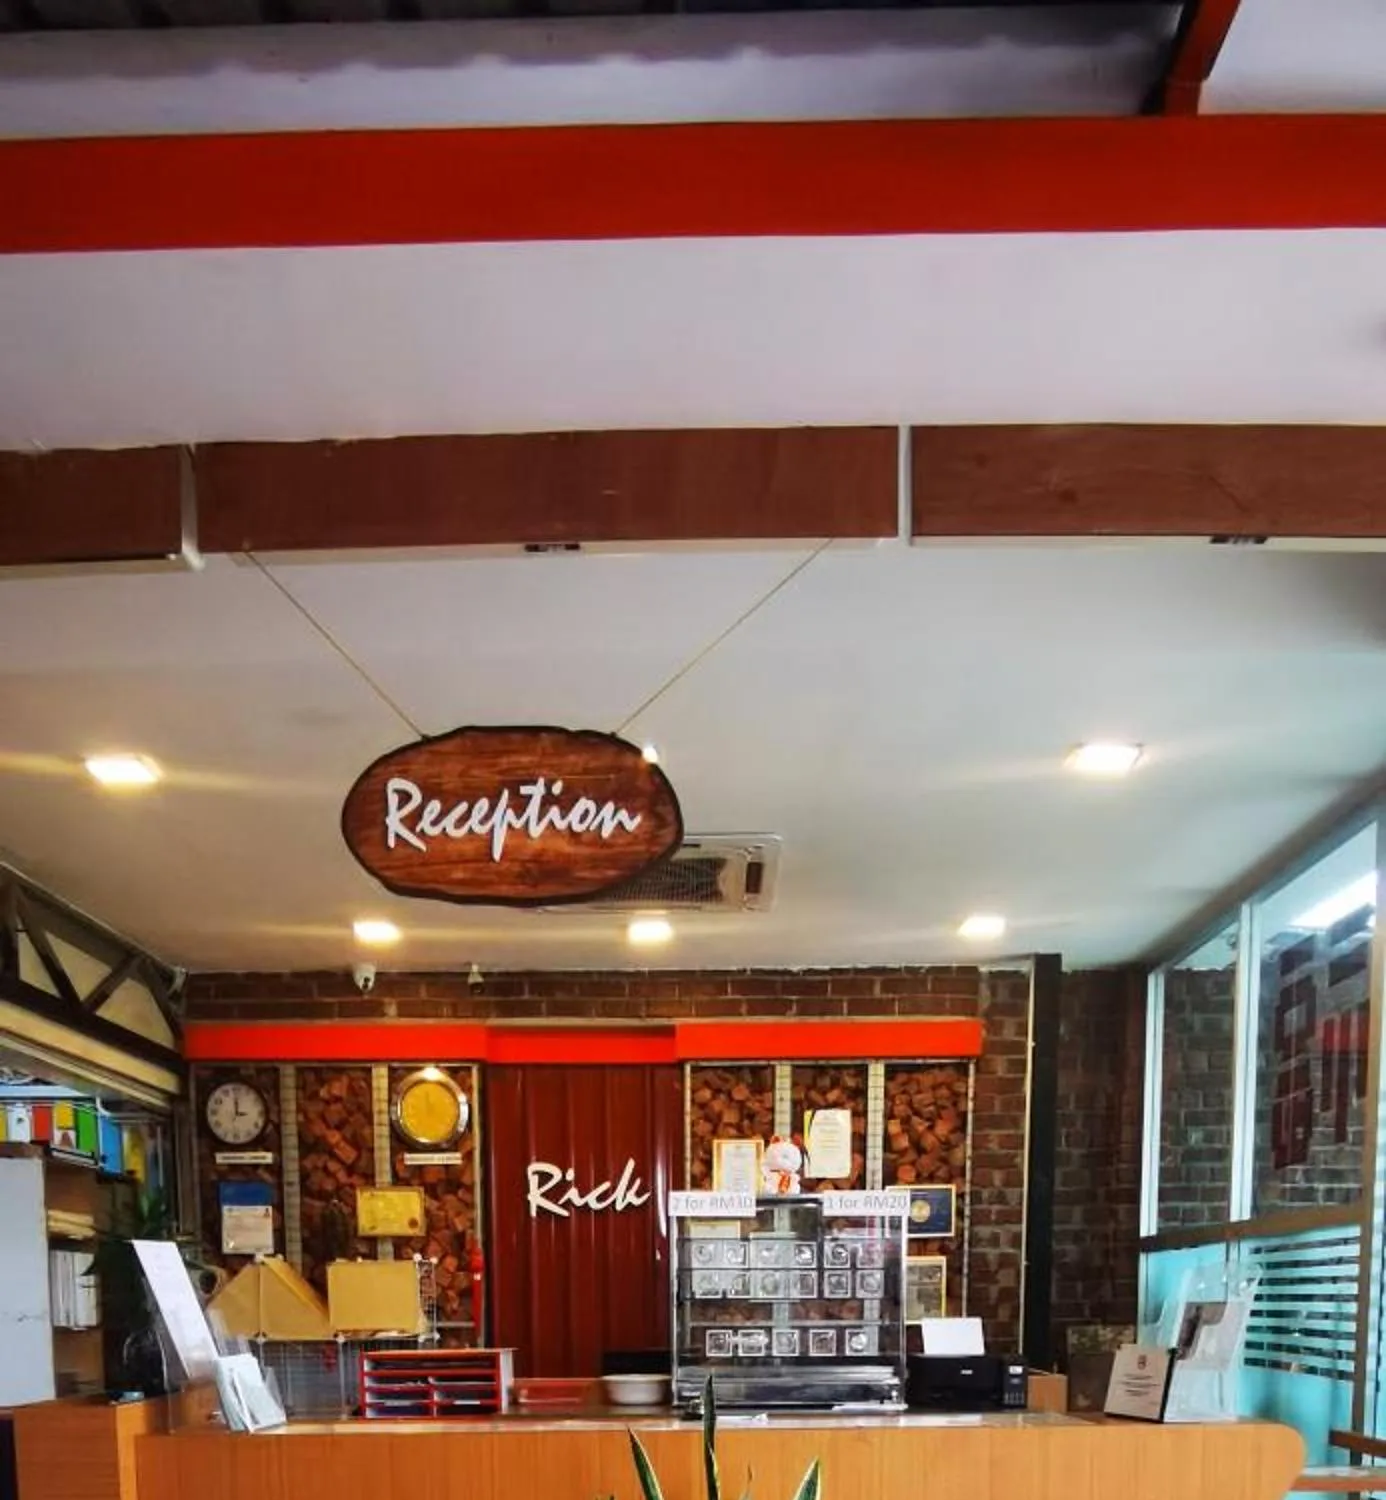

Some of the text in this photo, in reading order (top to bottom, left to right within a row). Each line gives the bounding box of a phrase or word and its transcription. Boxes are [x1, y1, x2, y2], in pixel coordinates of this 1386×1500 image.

[386, 777, 640, 861] Reception
[527, 1157, 652, 1217] Rick
[685, 1195, 704, 1209] for
[838, 1195, 858, 1209] for
